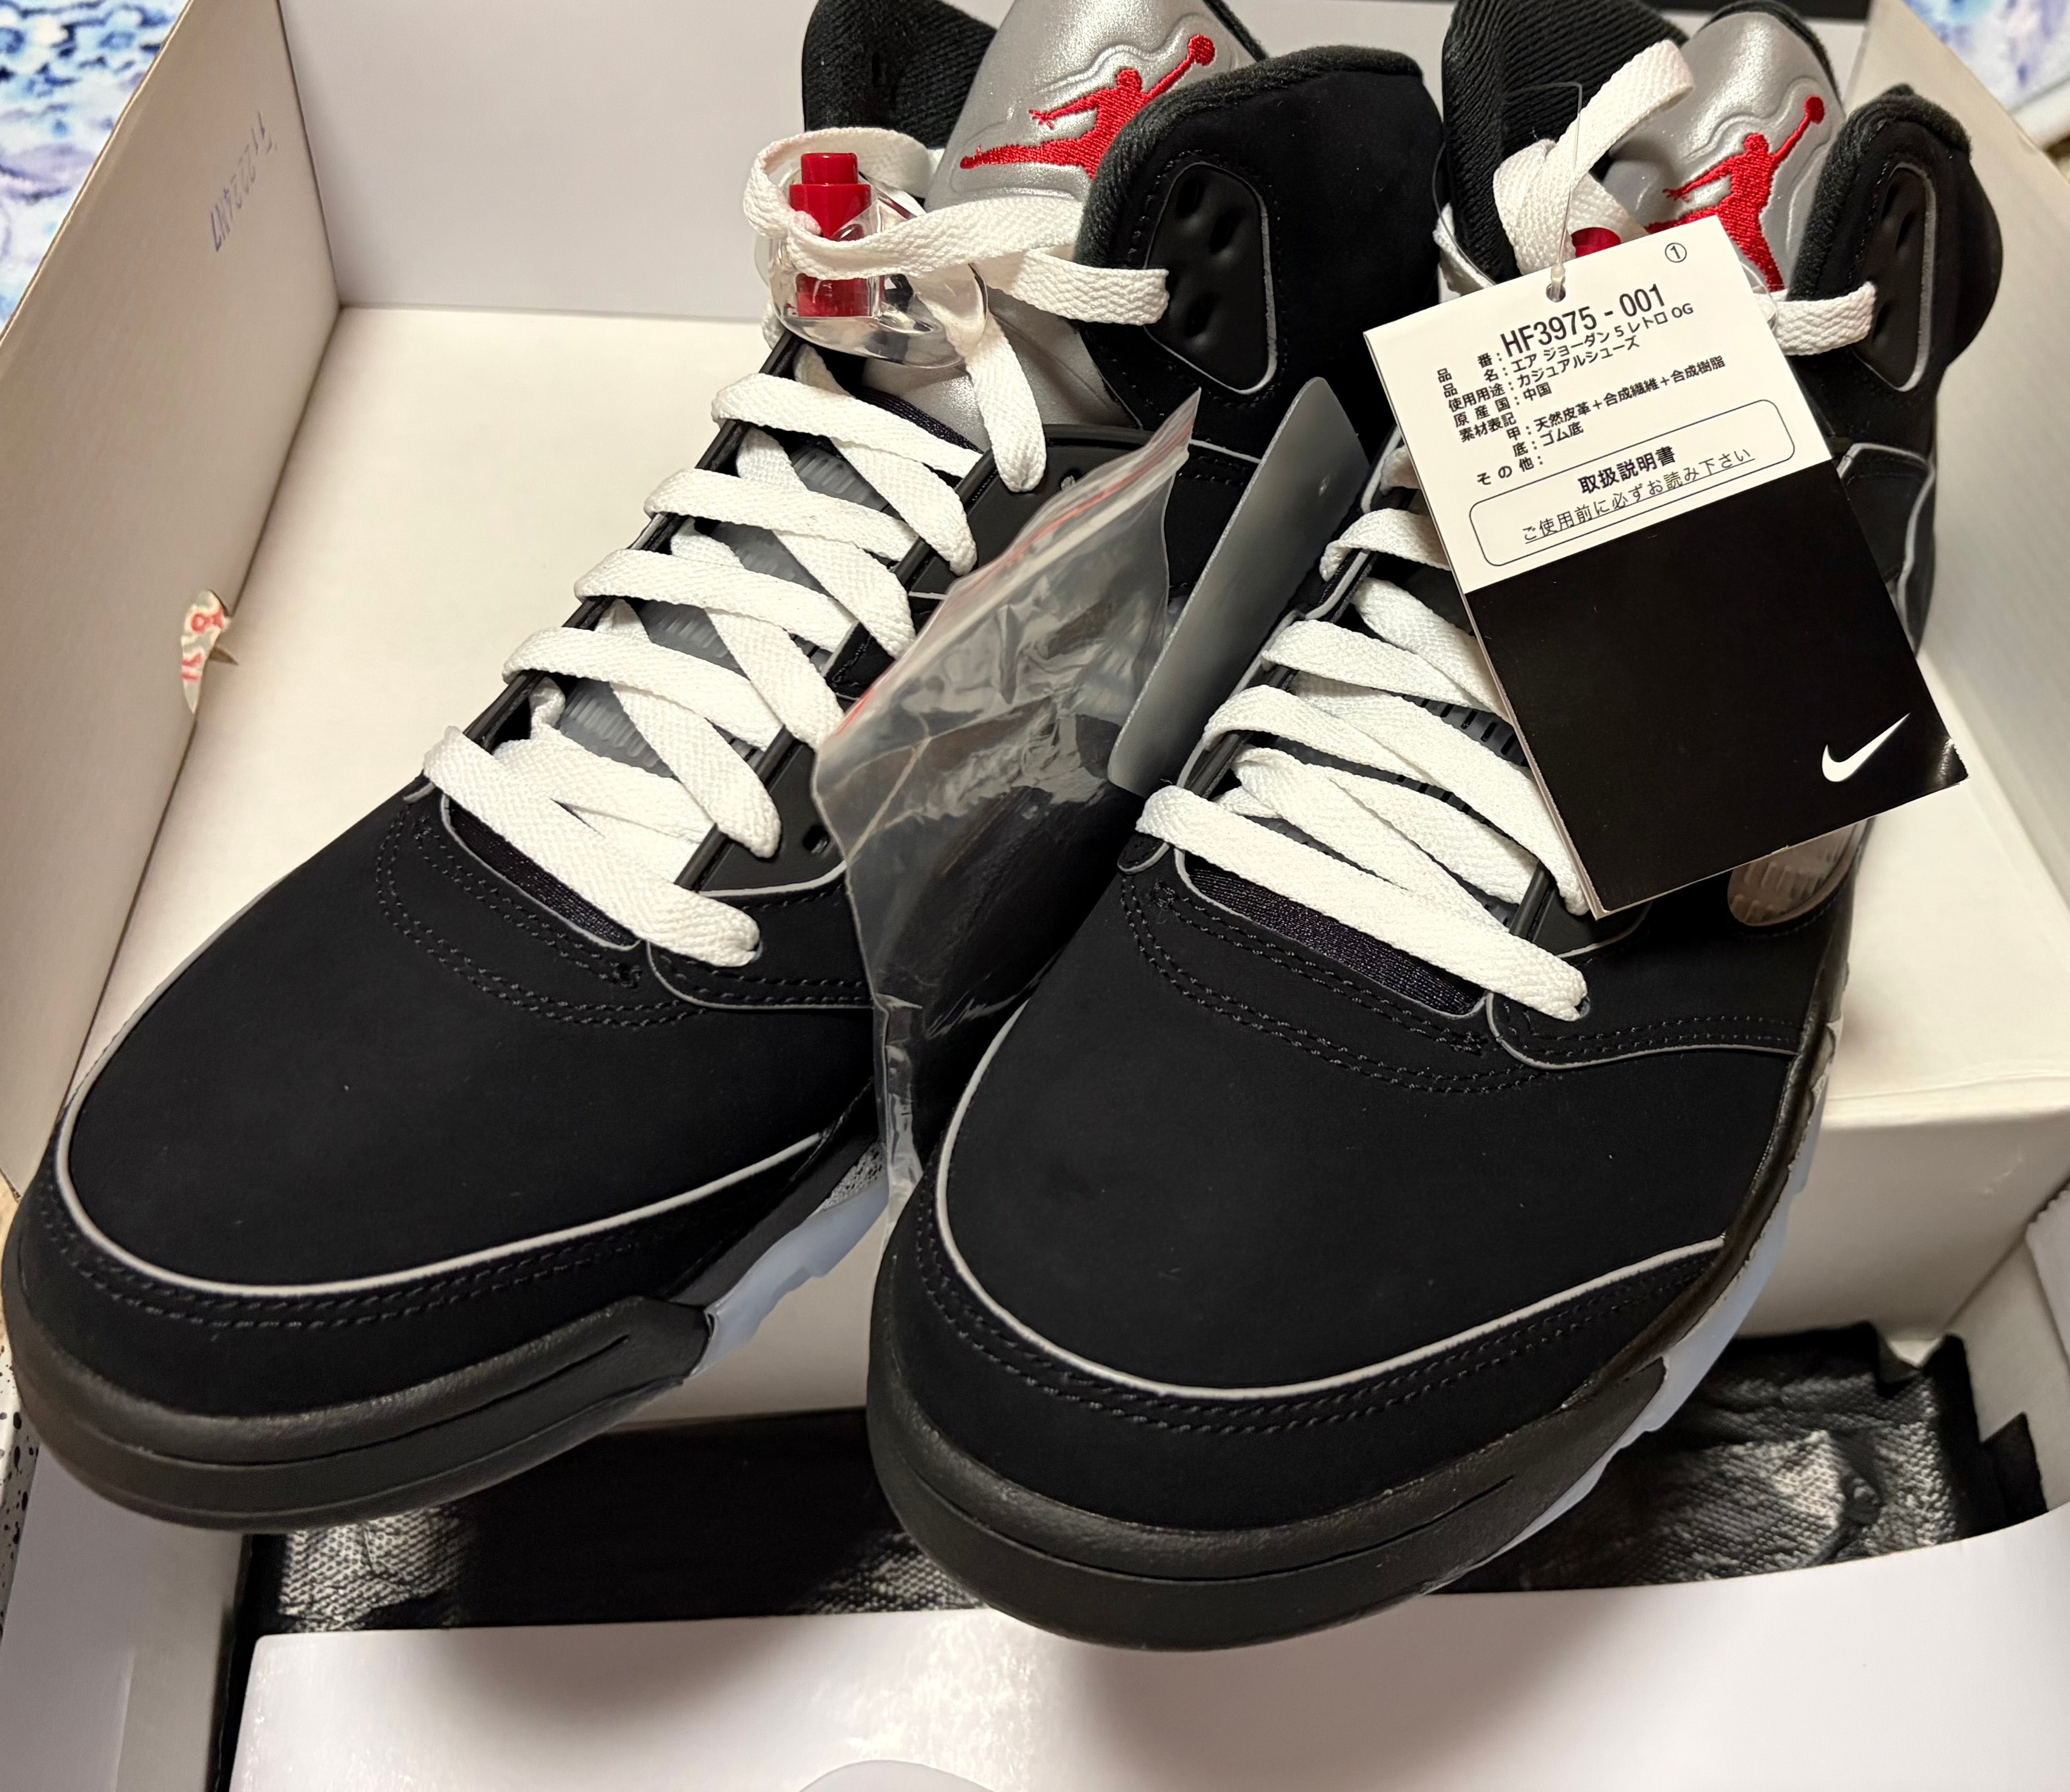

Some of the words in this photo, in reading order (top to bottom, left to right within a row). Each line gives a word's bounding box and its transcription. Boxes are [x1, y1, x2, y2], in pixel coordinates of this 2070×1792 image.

[1499, 305, 1597, 358] HF3975
[1618, 283, 1665, 317] 001
[1670, 303, 1694, 319] OG
